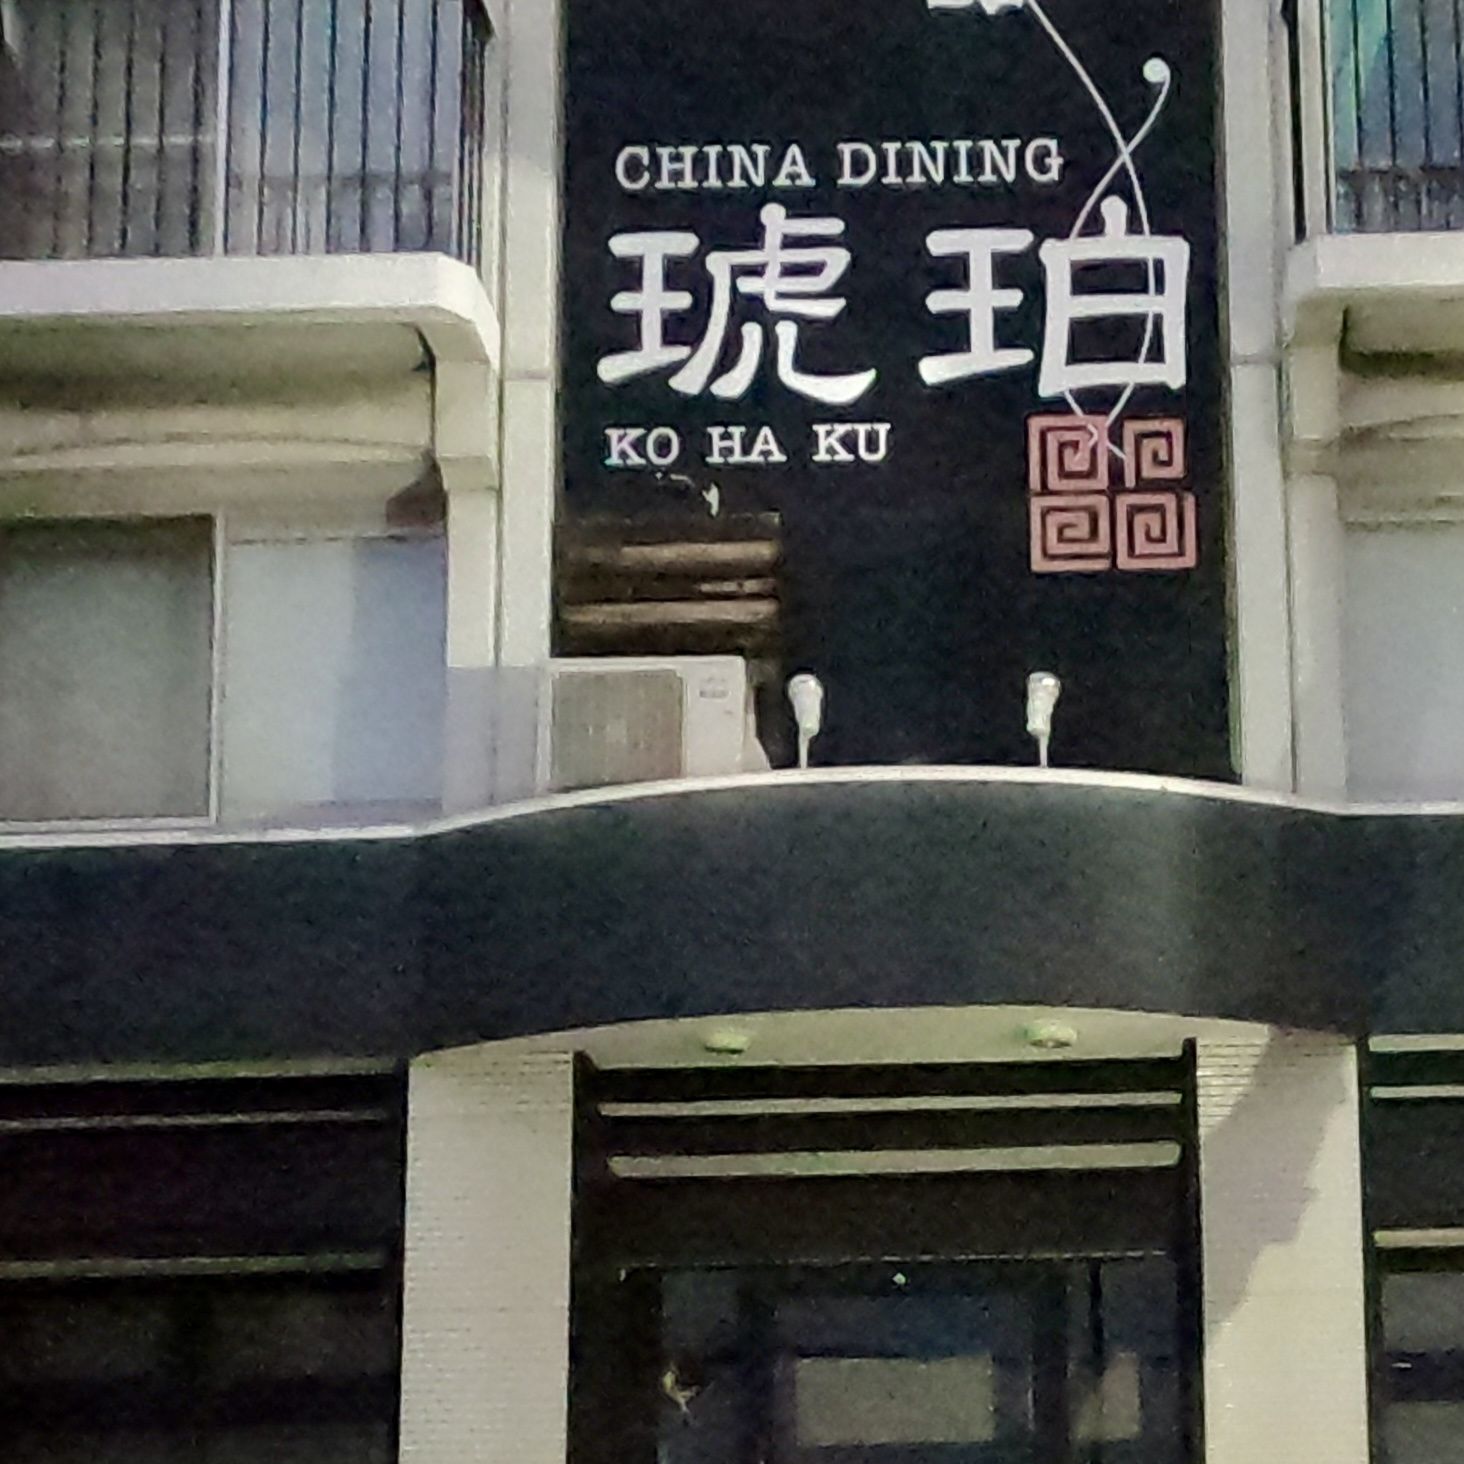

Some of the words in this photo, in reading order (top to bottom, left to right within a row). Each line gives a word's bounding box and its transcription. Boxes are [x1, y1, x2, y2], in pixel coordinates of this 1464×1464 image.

[616, 145, 815, 190] CHINA
[837, 138, 1064, 185] DINING
[598, 197, 1190, 405] 琥珀
[604, 427, 680, 465] KO
[705, 425, 787, 463] HA
[811, 422, 892, 463] KU
